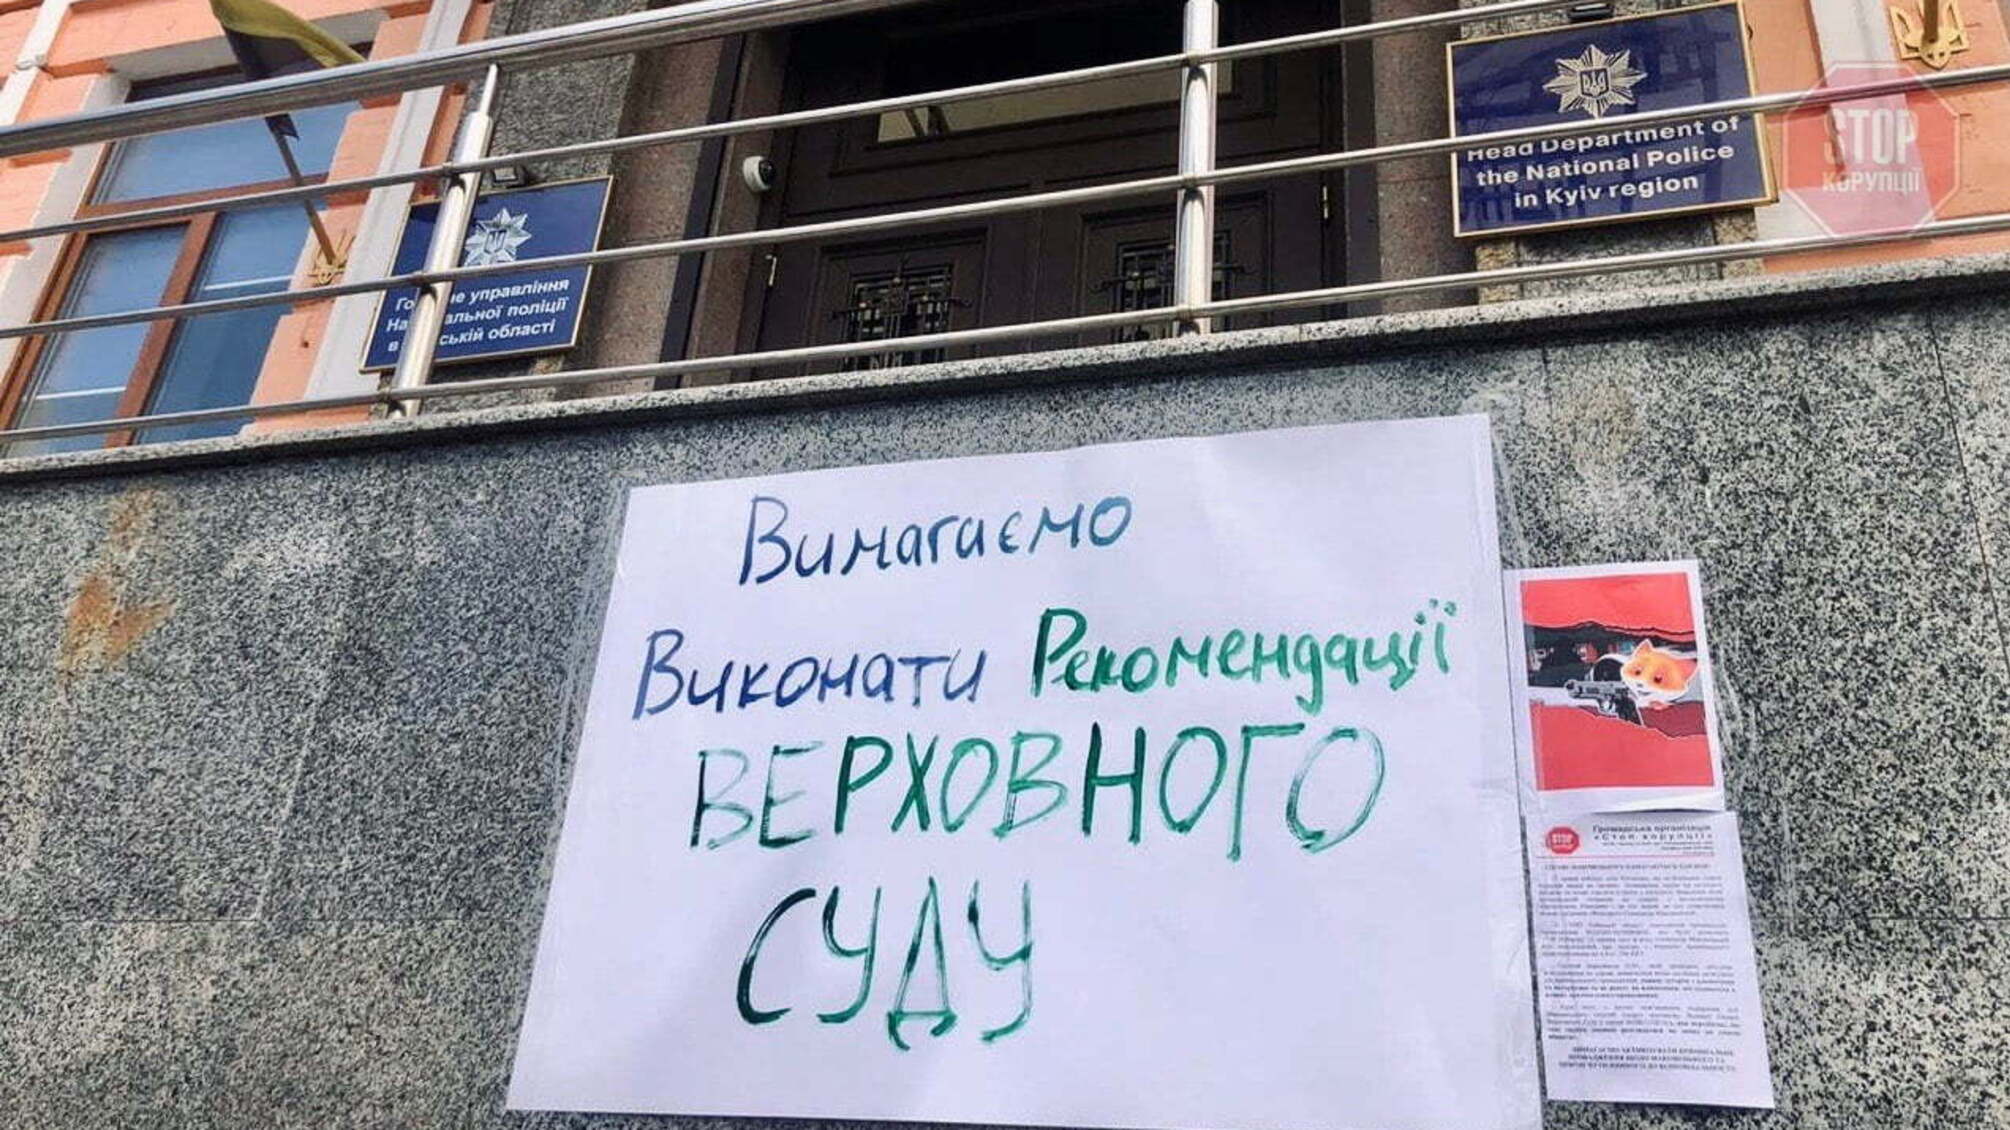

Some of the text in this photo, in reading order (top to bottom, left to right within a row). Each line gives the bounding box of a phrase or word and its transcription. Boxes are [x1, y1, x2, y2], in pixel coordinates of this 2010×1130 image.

[1468, 116, 1740, 162] Head Department of
[1476, 144, 1735, 186] the National Police
[1514, 174, 1699, 209] in Kyiv region
[386, 296, 570, 333] Наальної поліції
[469, 279, 570, 306] управління
[387, 341, 400, 352] в
[488, 318, 556, 340] області
[738, 495, 1133, 587] Вимагаємо
[631, 598, 1457, 721] Виконати Рекомендації
[689, 721, 1386, 862] ВЕРХОВНОГО
[735, 875, 1034, 1052] СУДУ
